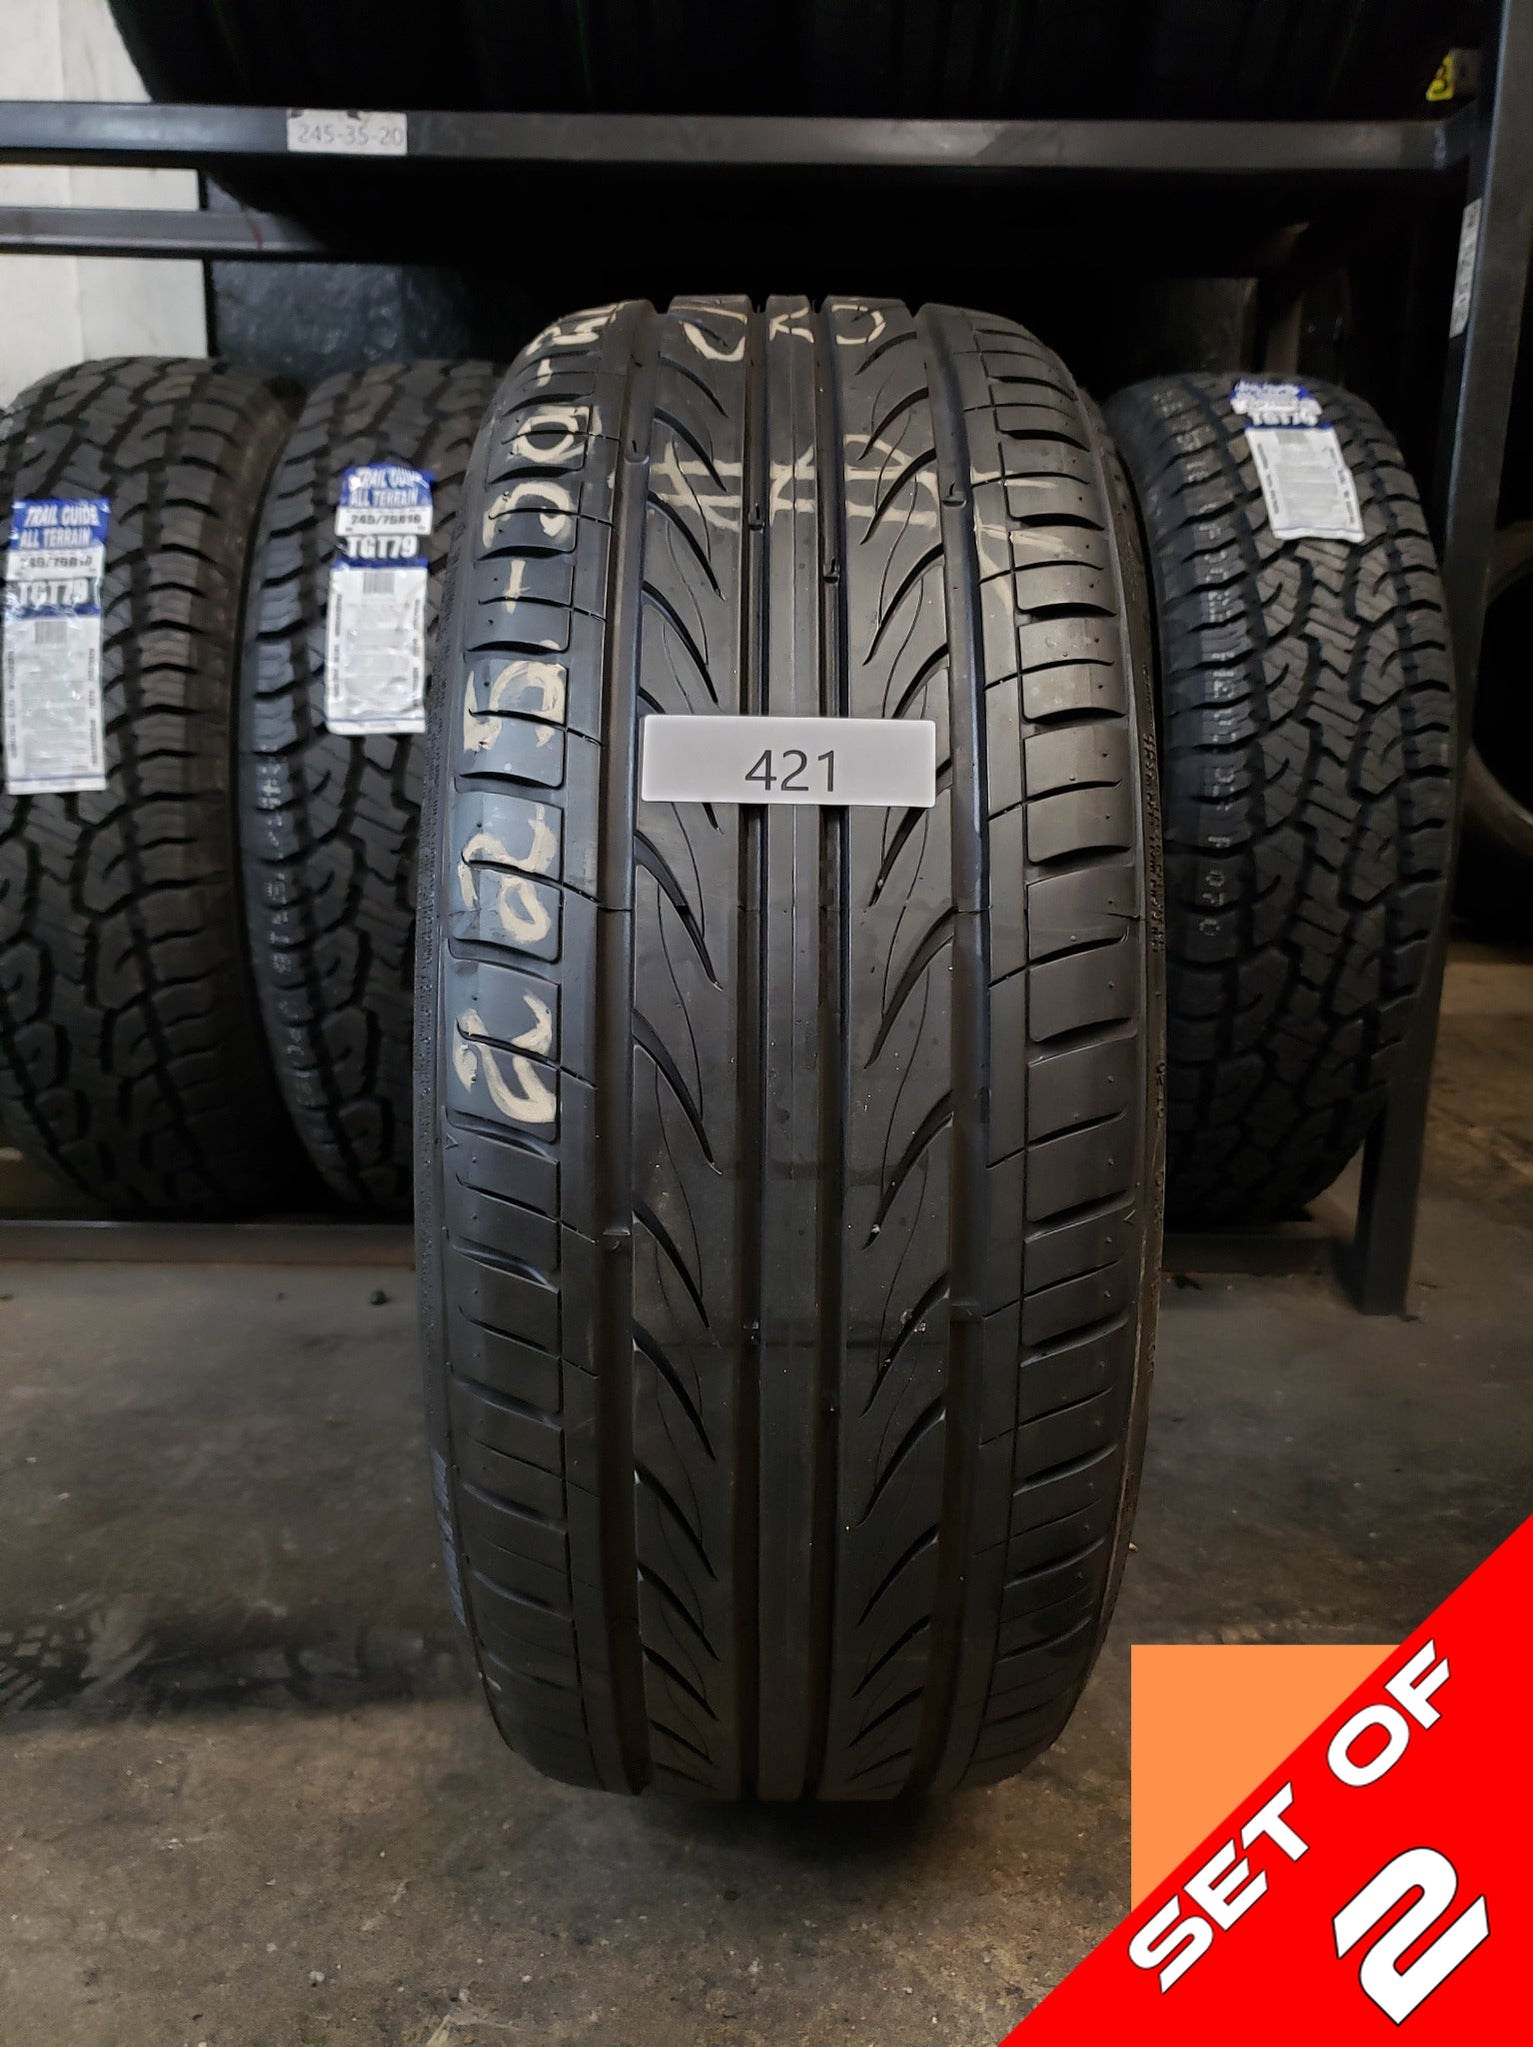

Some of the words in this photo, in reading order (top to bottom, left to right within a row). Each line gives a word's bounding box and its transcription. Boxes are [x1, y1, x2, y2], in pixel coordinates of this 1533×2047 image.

[298, 122, 404, 147] 245-35-20
[372, 487, 420, 507] TERRAIN
[23, 503, 59, 529] TRAIL
[20, 528, 40, 549] ALL
[43, 526, 92, 549] TERRAIN
[345, 535, 419, 560] TGT79
[18, 579, 89, 607] TGT79
[744, 750, 836, 792] 421
